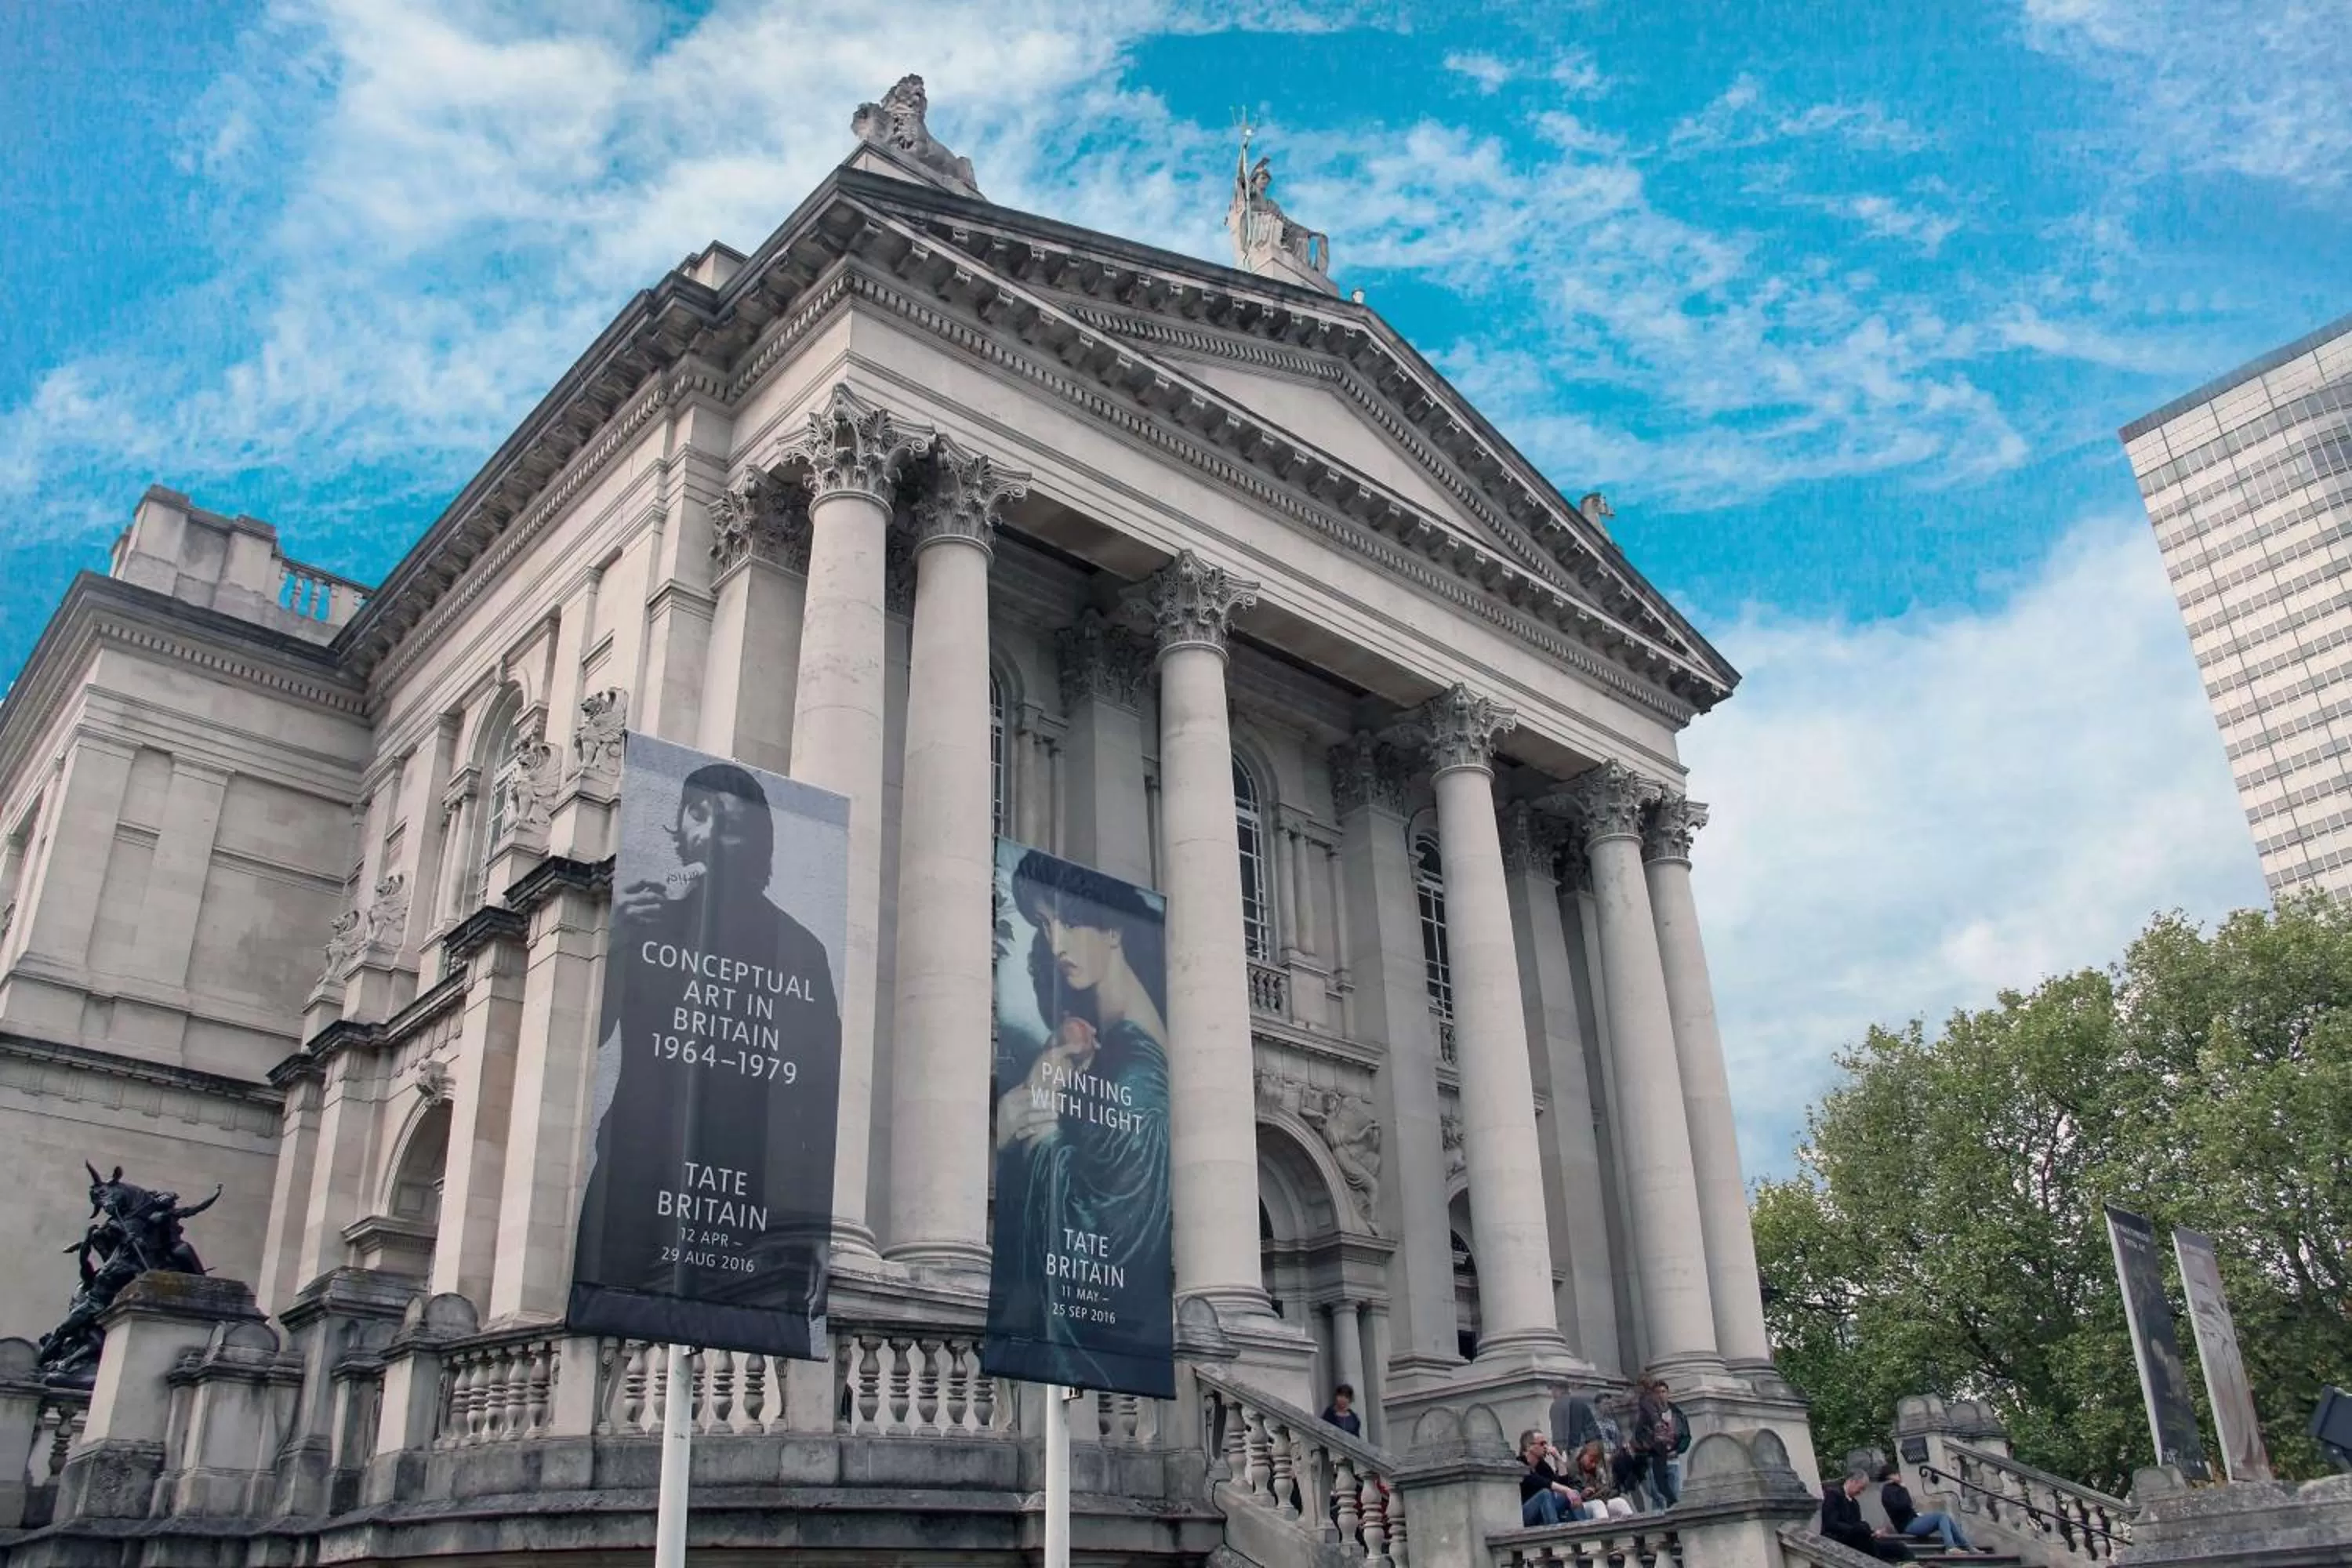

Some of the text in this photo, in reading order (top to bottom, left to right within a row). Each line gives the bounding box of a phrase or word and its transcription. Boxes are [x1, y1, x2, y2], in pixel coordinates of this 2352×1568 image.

[642, 941, 815, 1002] CONCEPTUAL
[683, 980, 773, 1020] ART IN
[673, 1007, 779, 1051] BRITAIN
[1042, 1062, 1132, 1107] PAINTING
[1031, 1085, 1143, 1134] WITH LIGHT
[684, 1162, 748, 1196] TATE
[657, 1191, 768, 1232] BRITAIN
[681, 1227, 695, 1243] 12
[700, 1232, 728, 1247] APR
[1063, 1228, 1109, 1258] TATE
[662, 1247, 755, 1273] 29 AUG 2016
[1046, 1253, 1124, 1289] BRITAIN
[1062, 1285, 1071, 1298] 11
[1076, 1287, 1098, 1302] MAY
[1053, 1302, 1116, 1324] 25 SEP 2016
